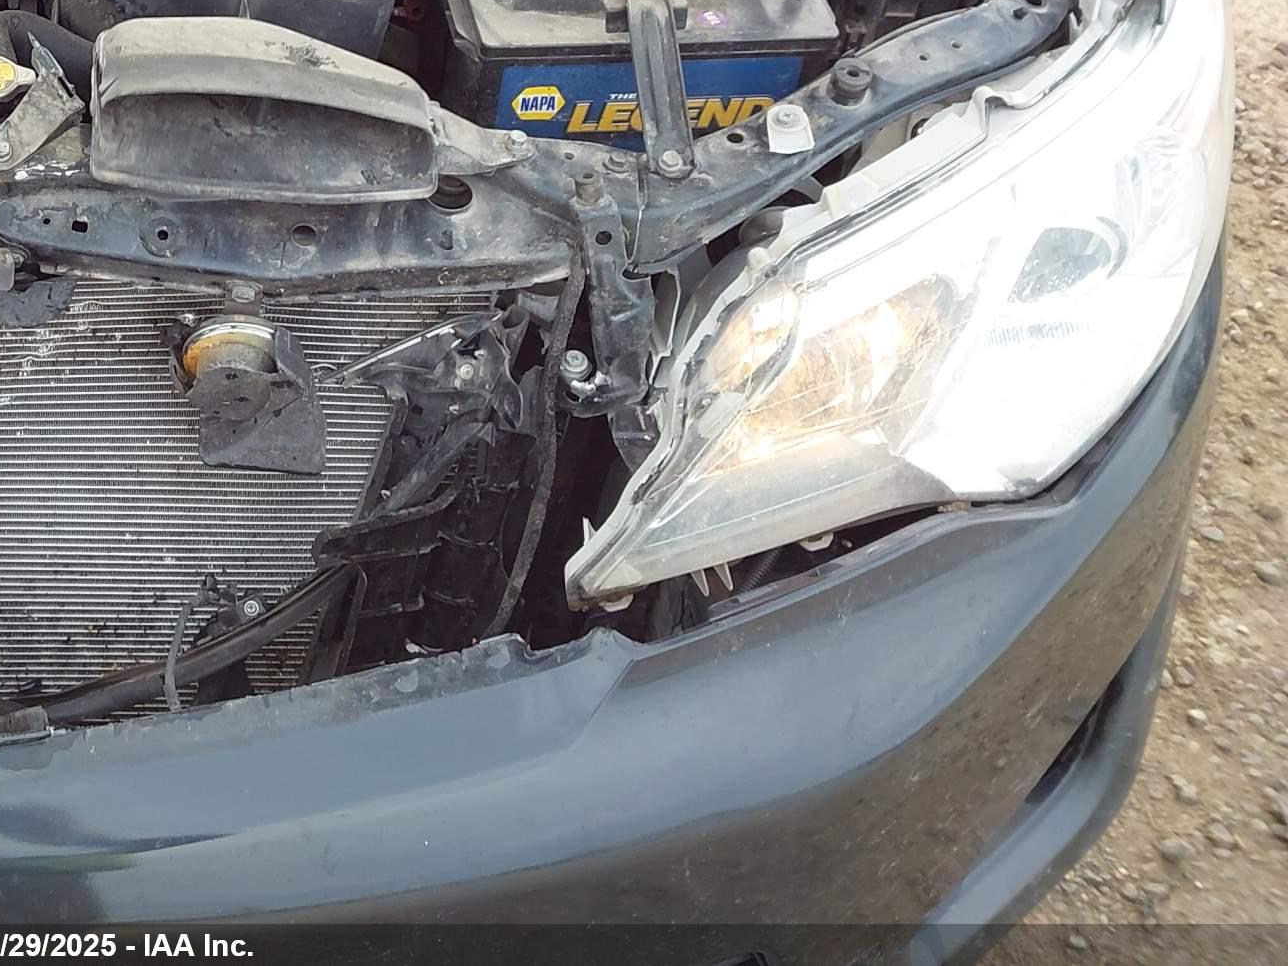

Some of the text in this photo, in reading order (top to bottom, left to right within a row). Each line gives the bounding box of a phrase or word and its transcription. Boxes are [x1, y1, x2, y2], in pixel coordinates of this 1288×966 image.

[519, 96, 556, 112] NAPA
[609, 92, 638, 101] THE
[567, 96, 776, 132] LEND
